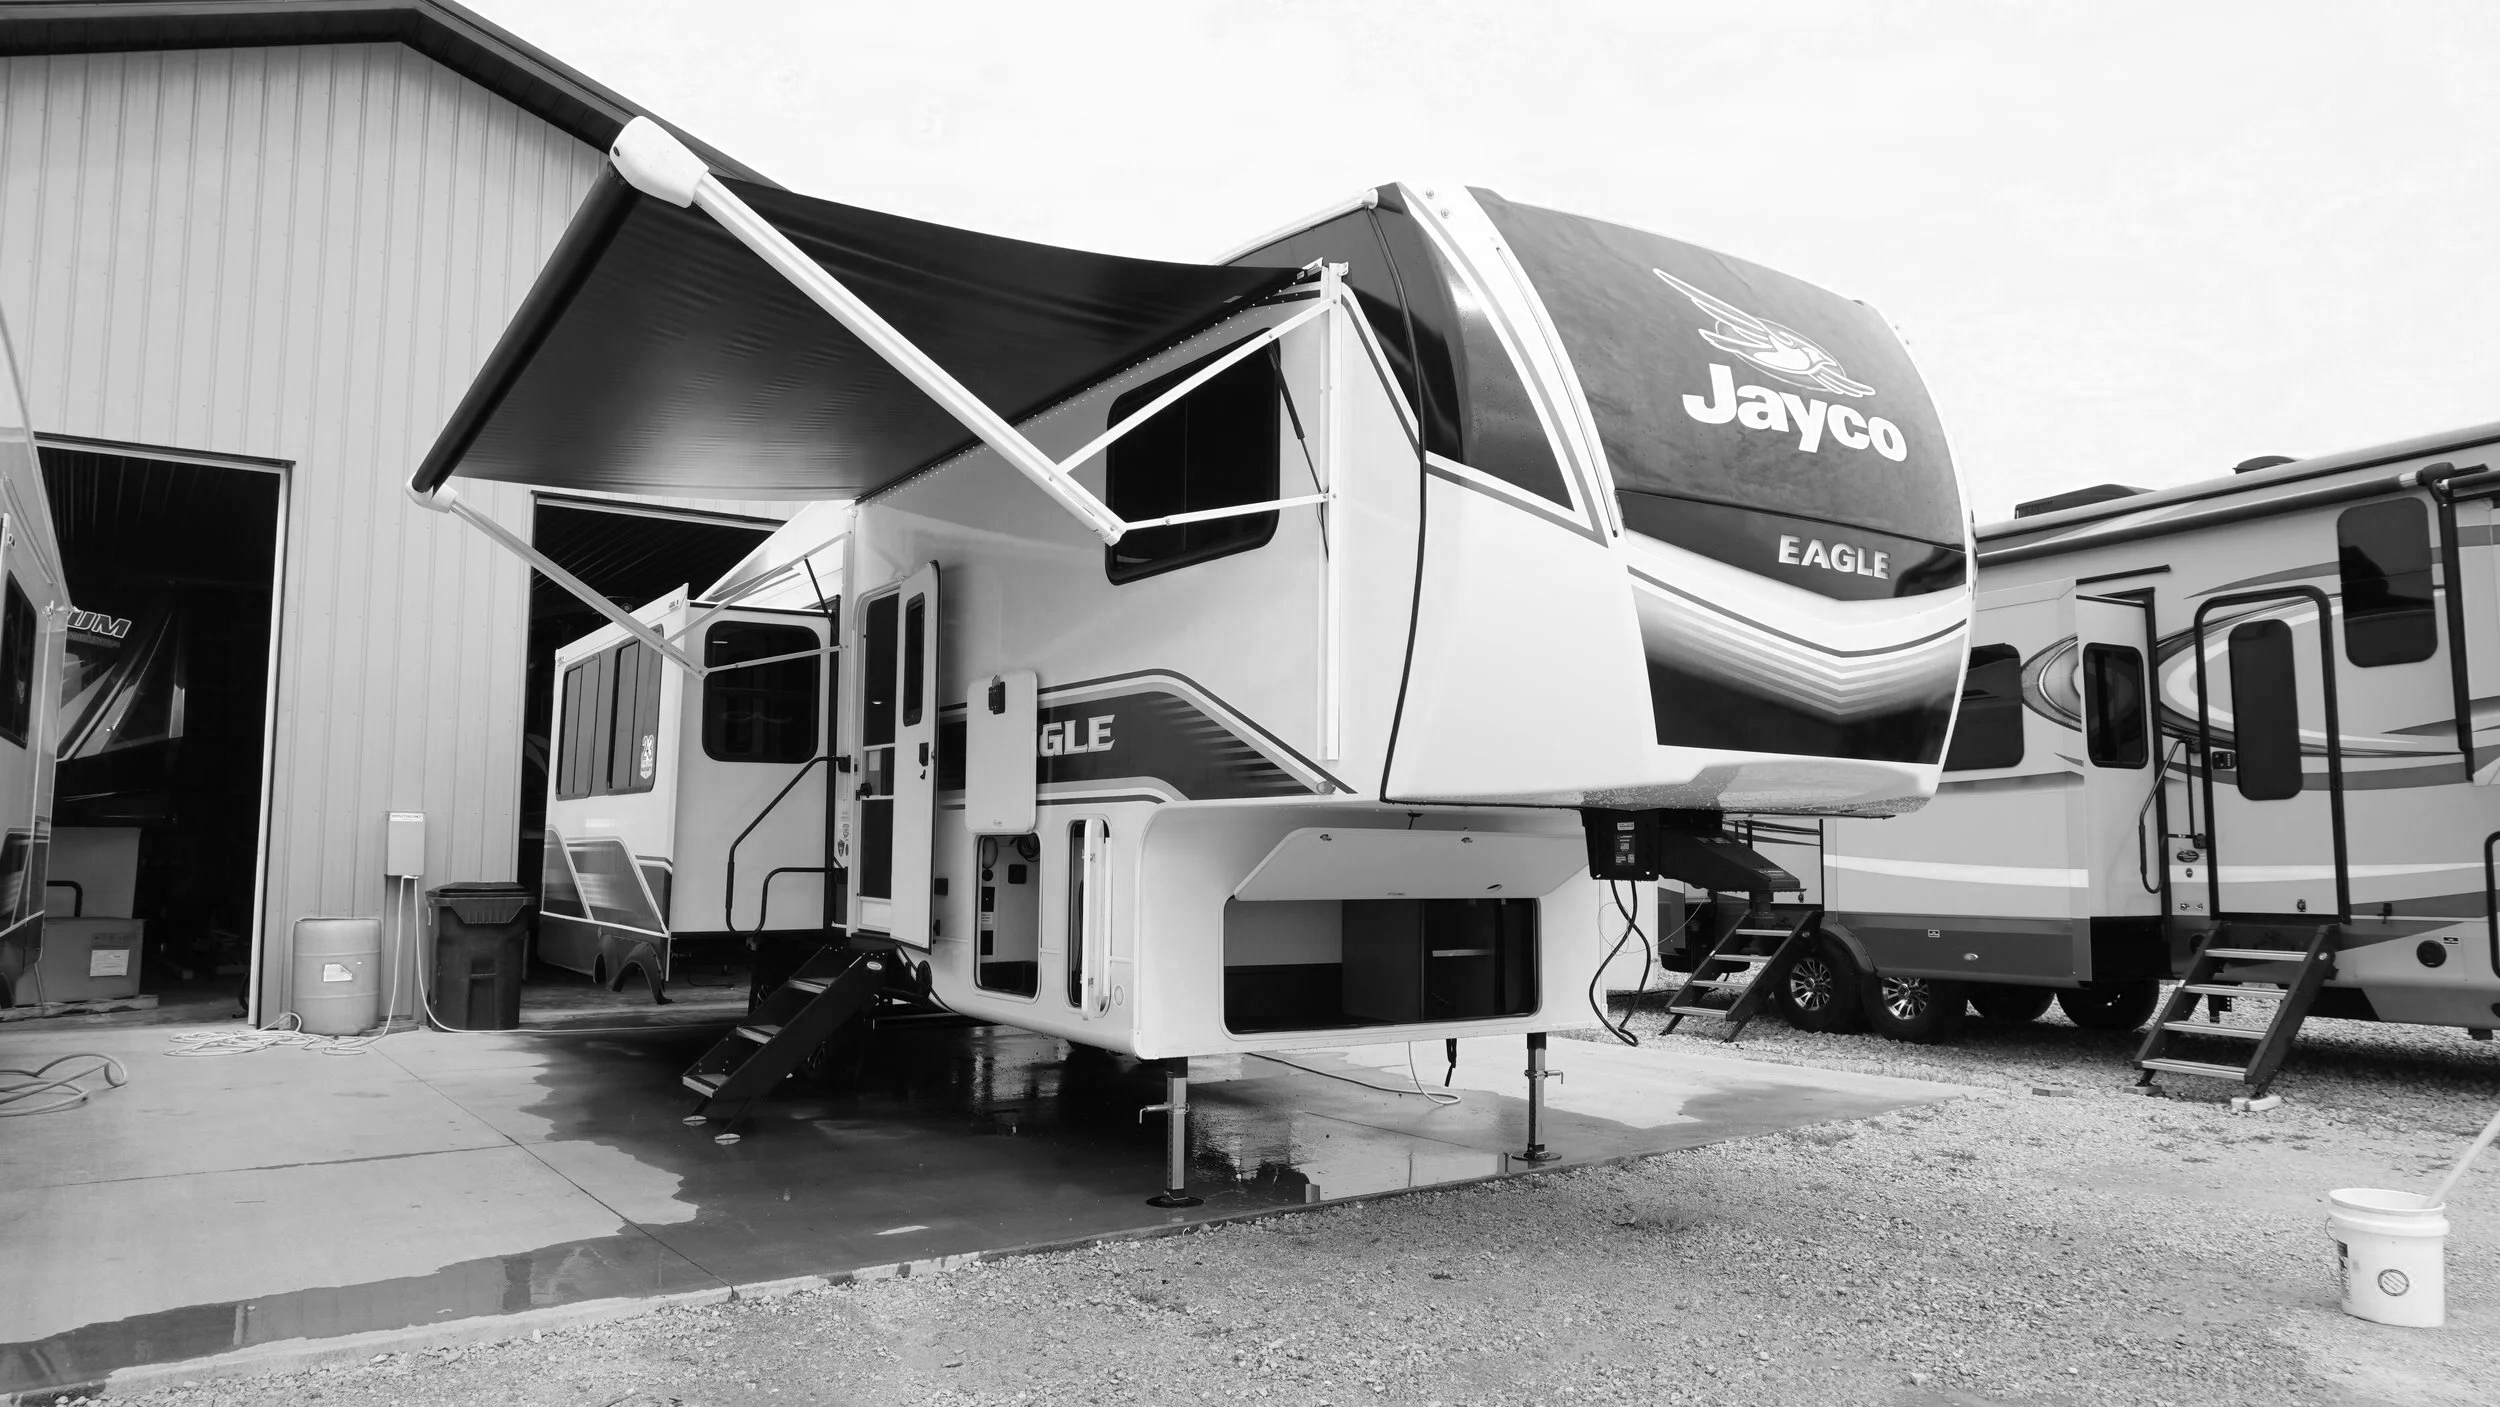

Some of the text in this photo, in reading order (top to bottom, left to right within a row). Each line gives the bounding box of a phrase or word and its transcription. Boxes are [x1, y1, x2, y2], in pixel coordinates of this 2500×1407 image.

[1682, 363, 1908, 462] Jayco
[1779, 534, 1890, 579] EAGLE
[1038, 714, 1115, 757] GLE
